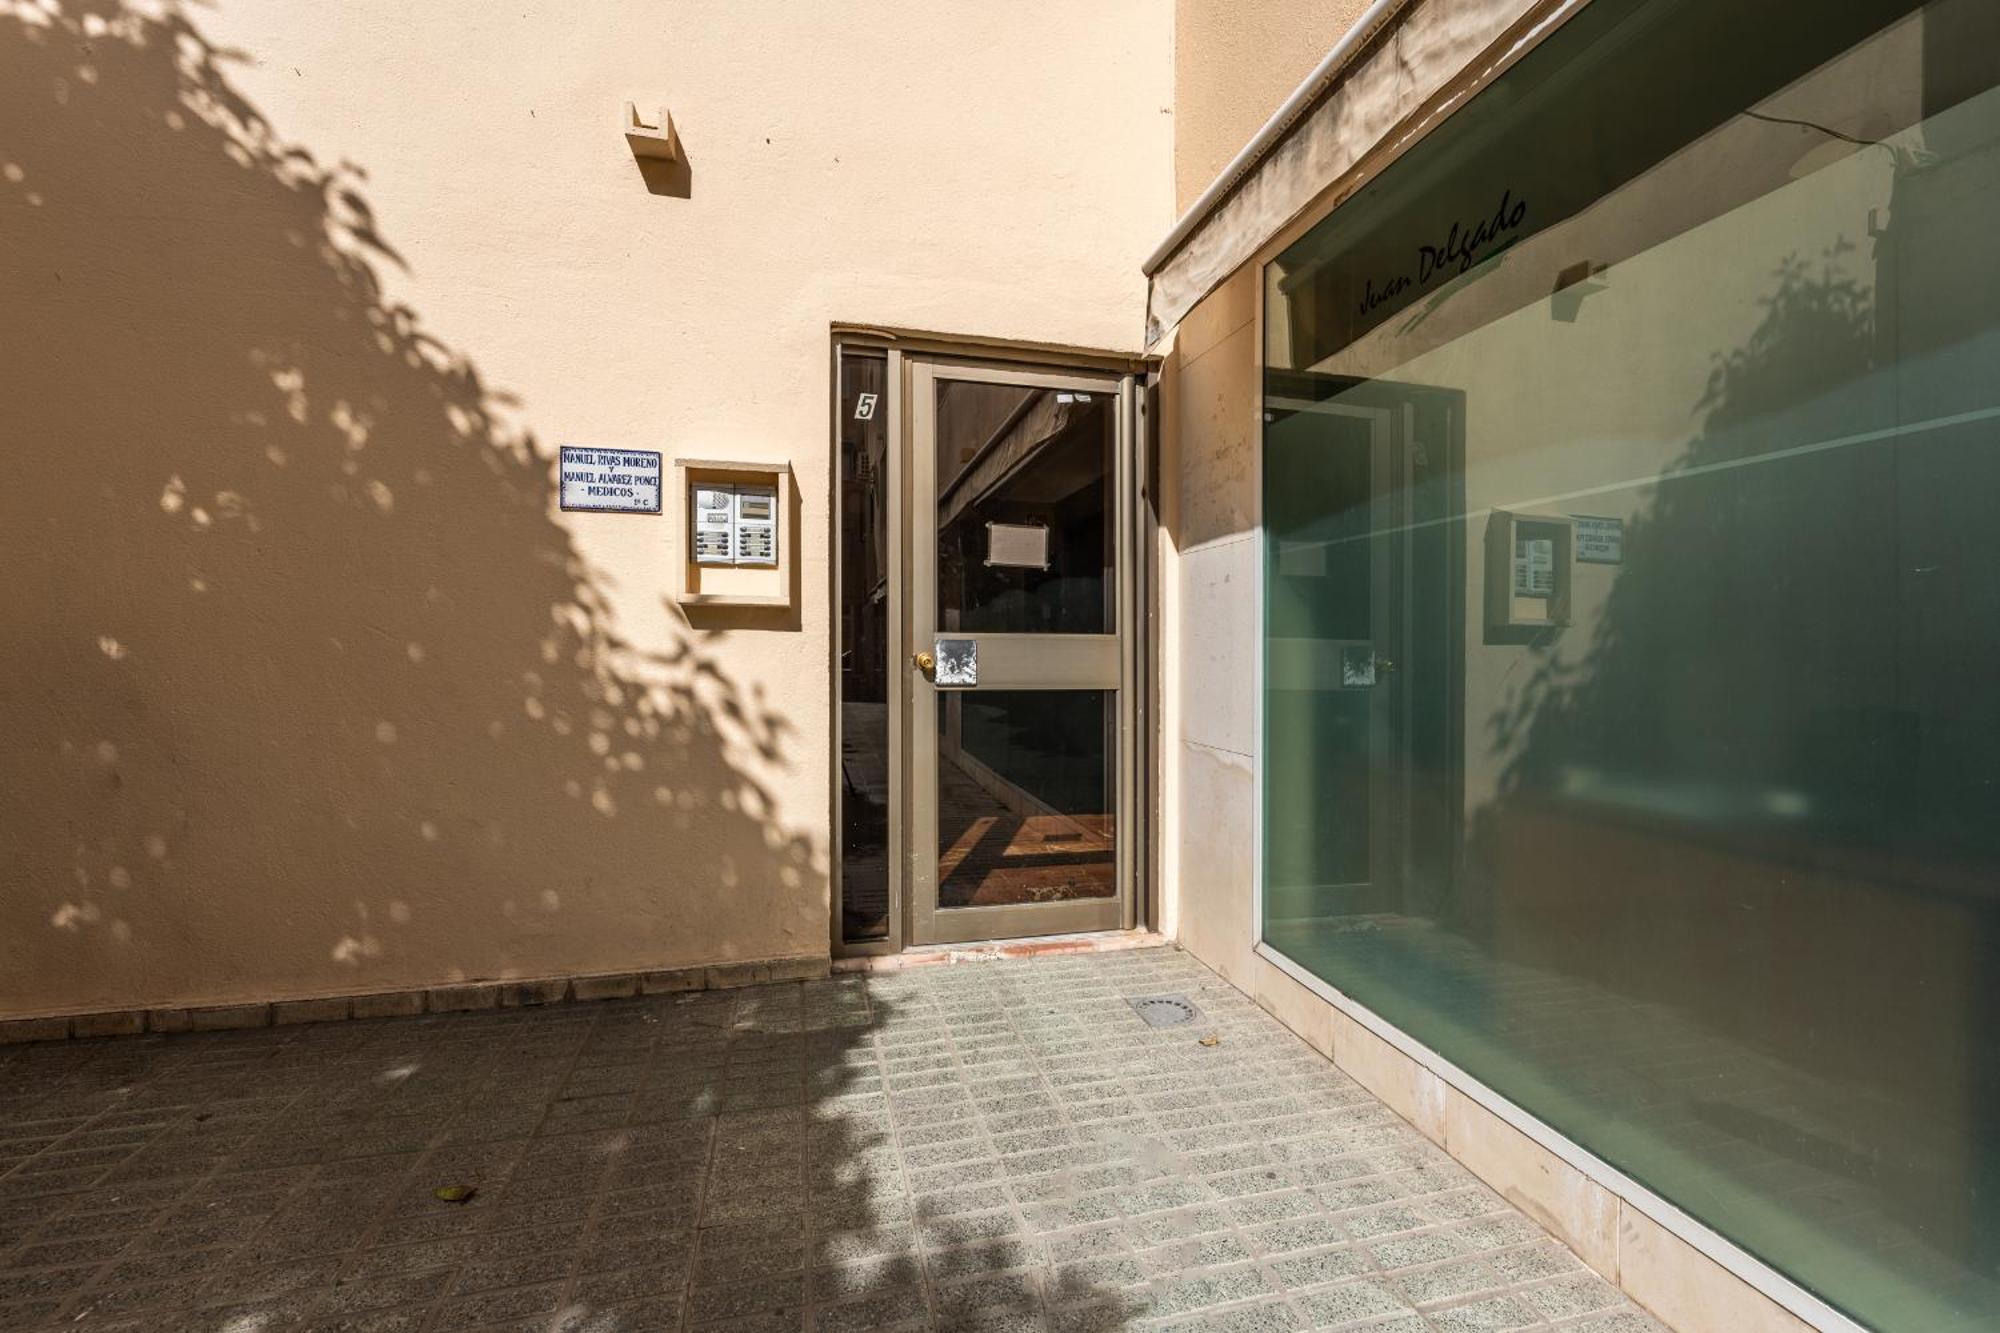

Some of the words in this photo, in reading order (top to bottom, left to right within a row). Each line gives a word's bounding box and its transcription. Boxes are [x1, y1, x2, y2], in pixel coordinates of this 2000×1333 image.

[1359, 279, 1412, 316] Juan
[1418, 189, 1526, 288] Delgado
[859, 395, 874, 417] 5
[563, 453, 595, 465] MANUEL
[597, 454, 621, 467] RIVAS
[622, 456, 658, 469] MORENO
[563, 472, 596, 484] MANUEL
[634, 475, 658, 486] PONCE
[587, 486, 634, 497] MEDICOS
